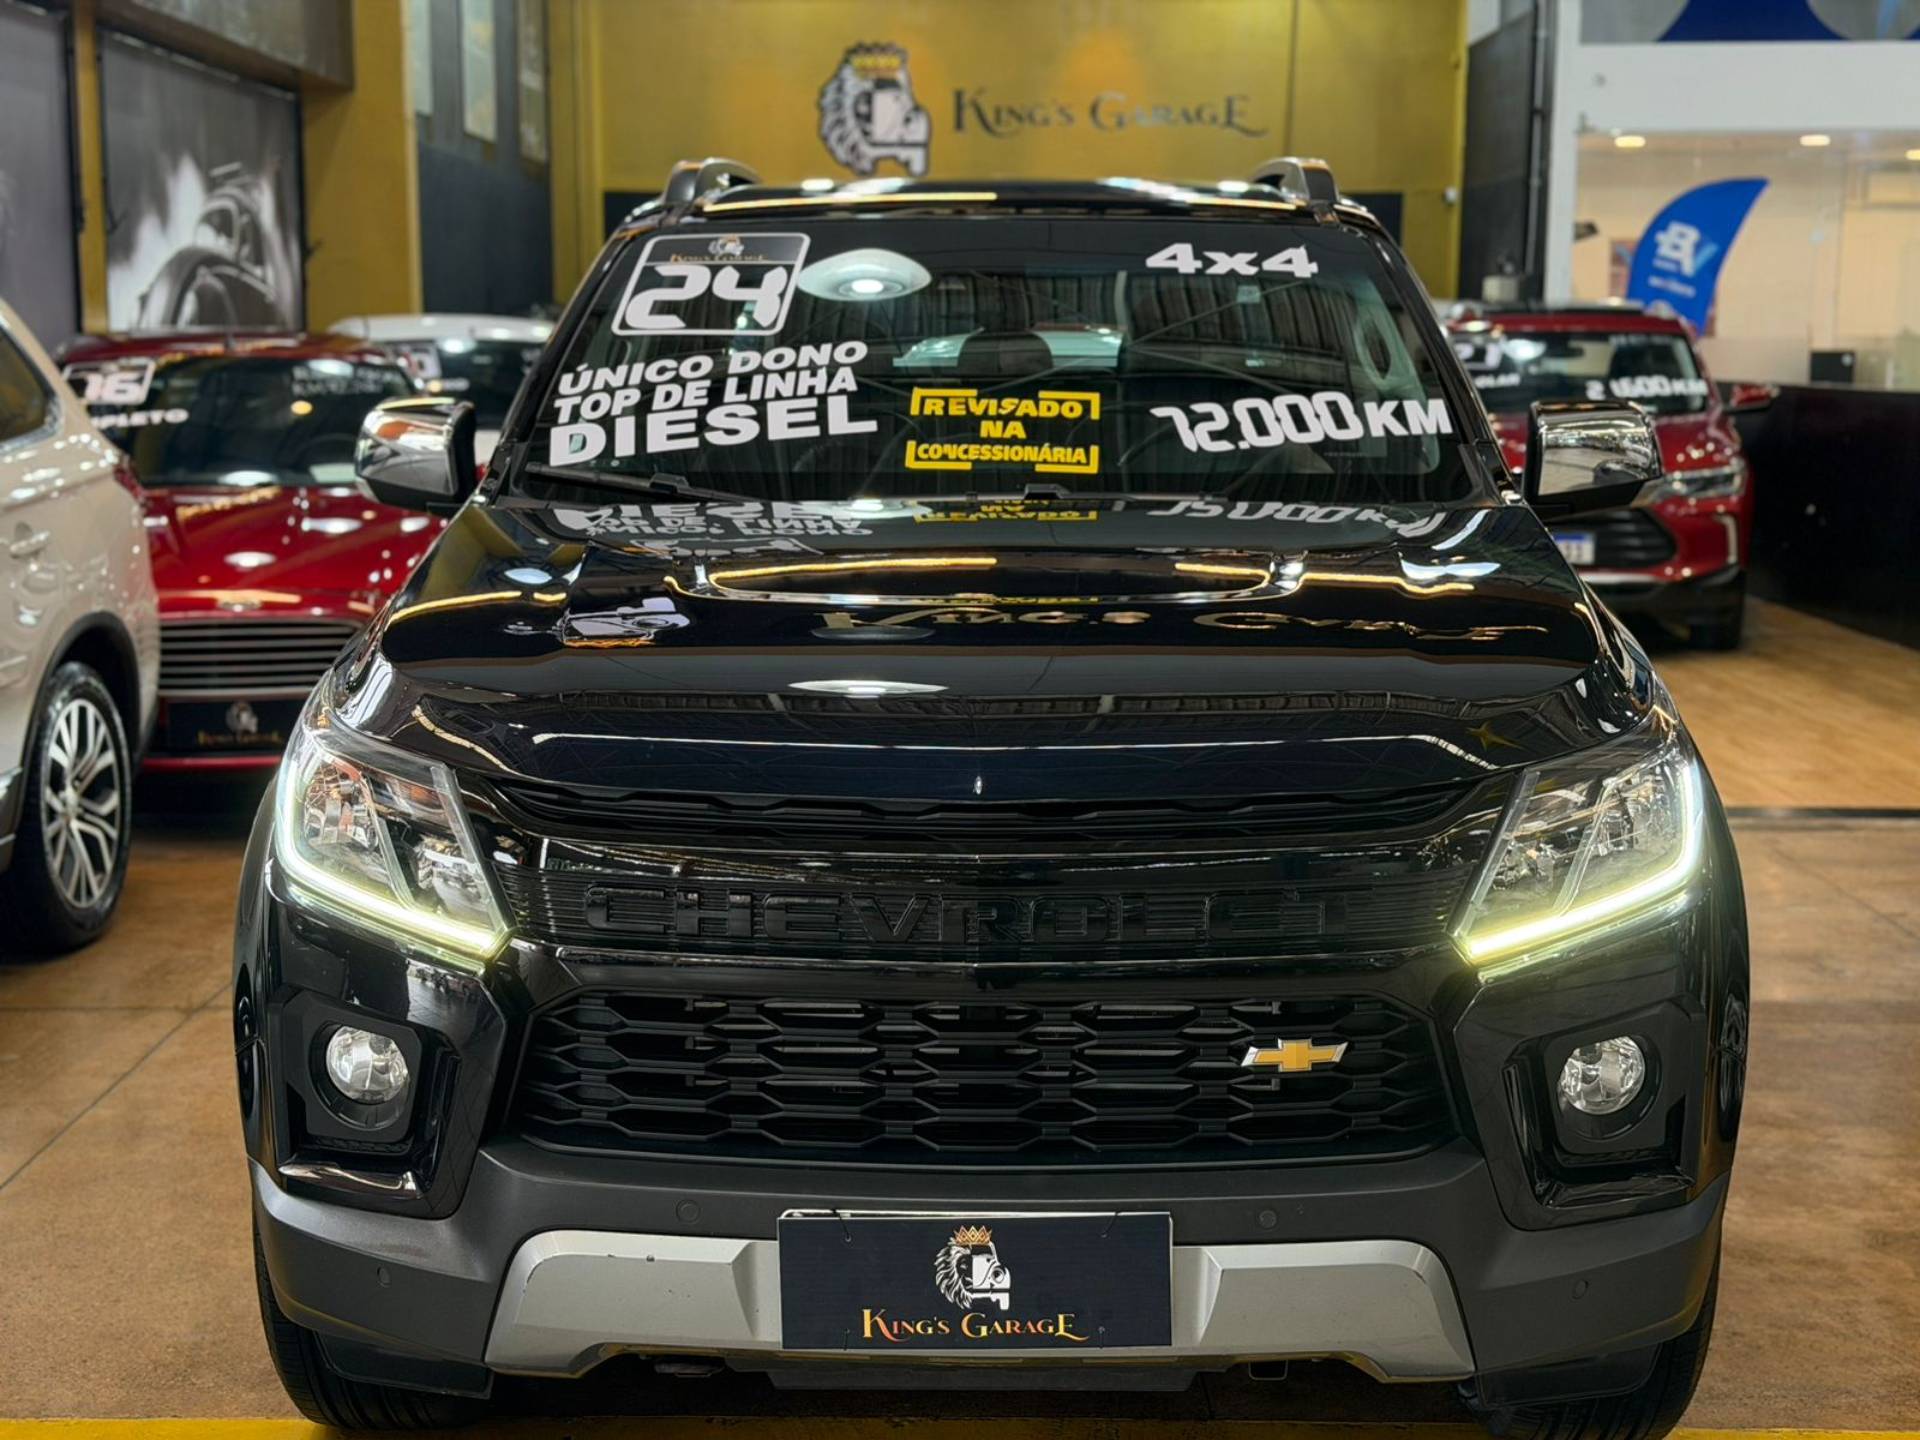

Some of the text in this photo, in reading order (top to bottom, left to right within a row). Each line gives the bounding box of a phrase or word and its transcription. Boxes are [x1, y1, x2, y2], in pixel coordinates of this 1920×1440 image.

[625, 265, 788, 329] 24
[553, 366, 859, 424] TOP DE LINHA
[558, 340, 868, 396] ÚNICO DONO
[549, 395, 878, 467] DIESEL
[923, 397, 1083, 418] REVISADO
[979, 420, 1027, 439] NA
[584, 882, 1375, 944] CHEVROLET
